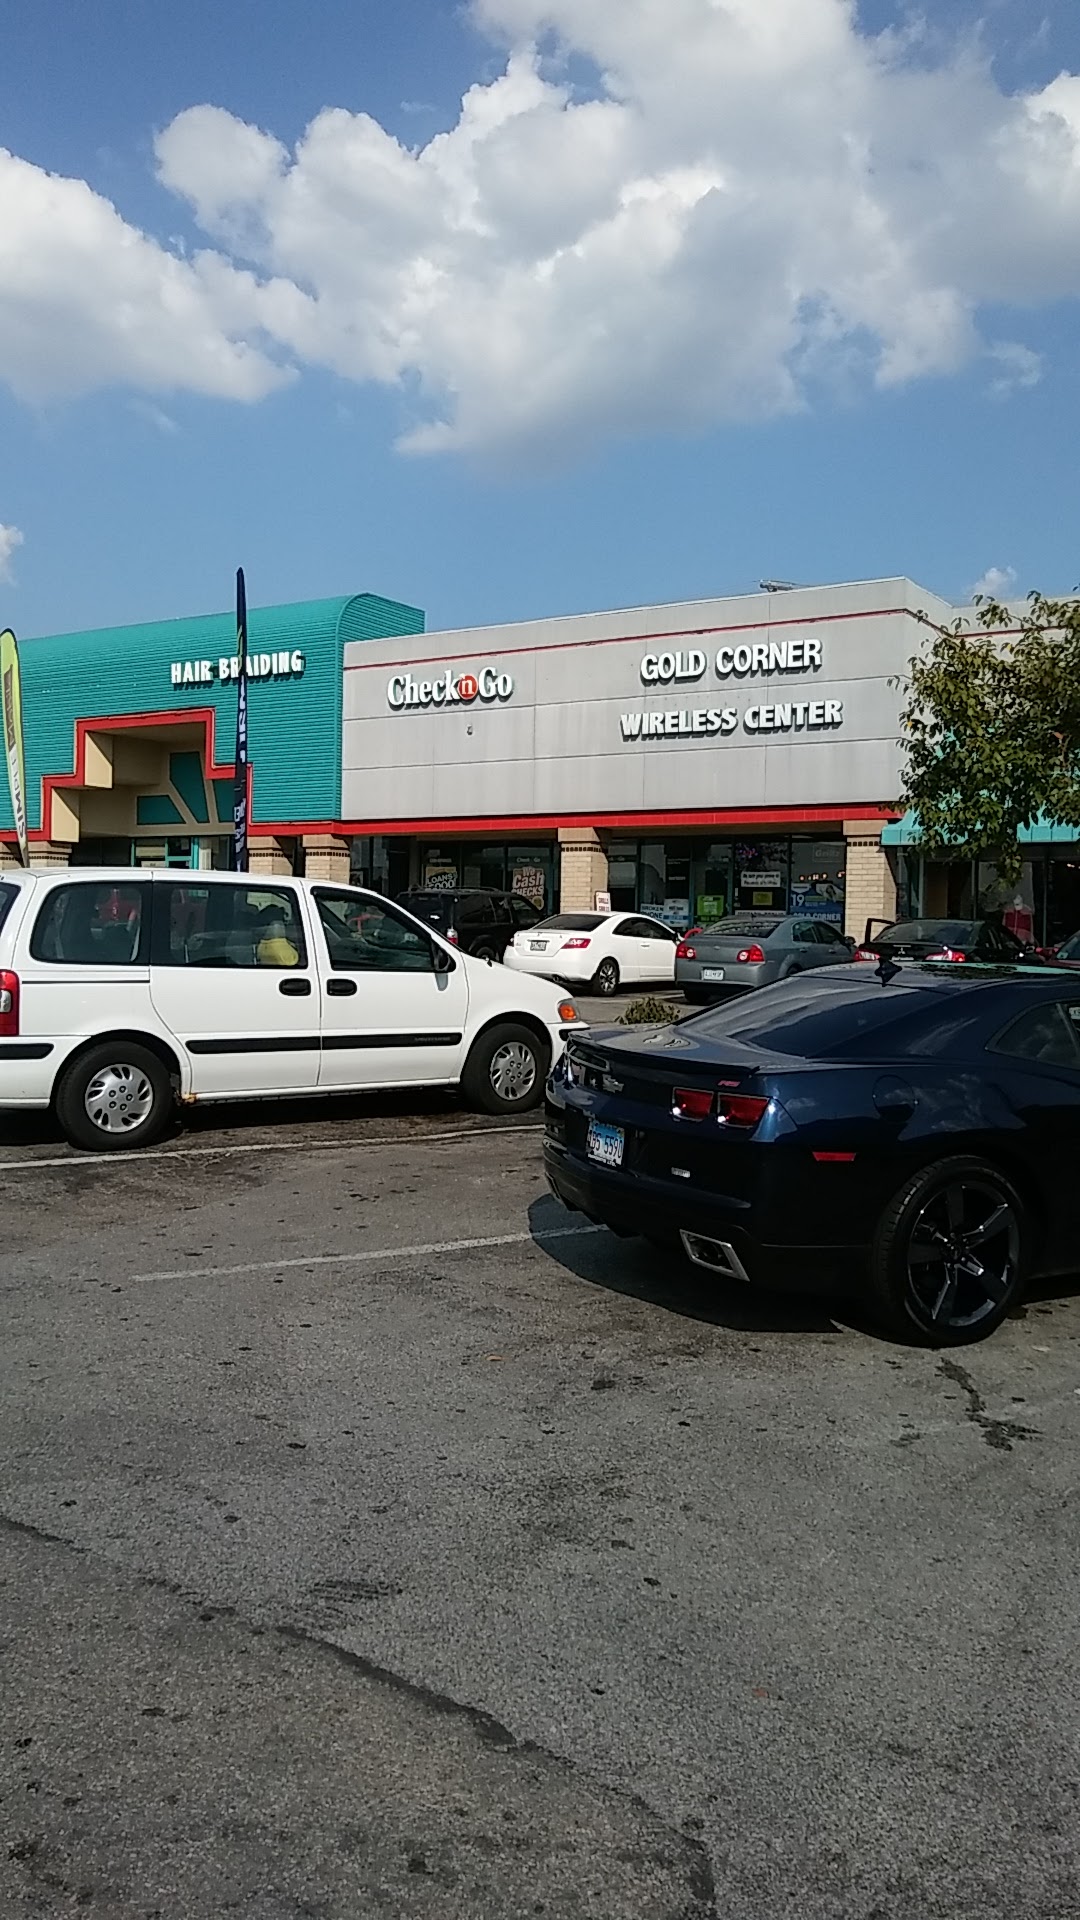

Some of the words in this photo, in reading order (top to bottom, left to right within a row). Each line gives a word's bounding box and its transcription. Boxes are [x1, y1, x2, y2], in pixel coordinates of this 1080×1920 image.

[171, 660, 212, 684] HAIR
[640, 650, 707, 681] GOLD
[715, 639, 823, 674] CORNER
[387, 669, 461, 706] Check
[478, 666, 513, 698] Go
[620, 707, 738, 736] WIRELESS
[744, 699, 843, 729] CENTER
[512, 872, 545, 889] Cash
